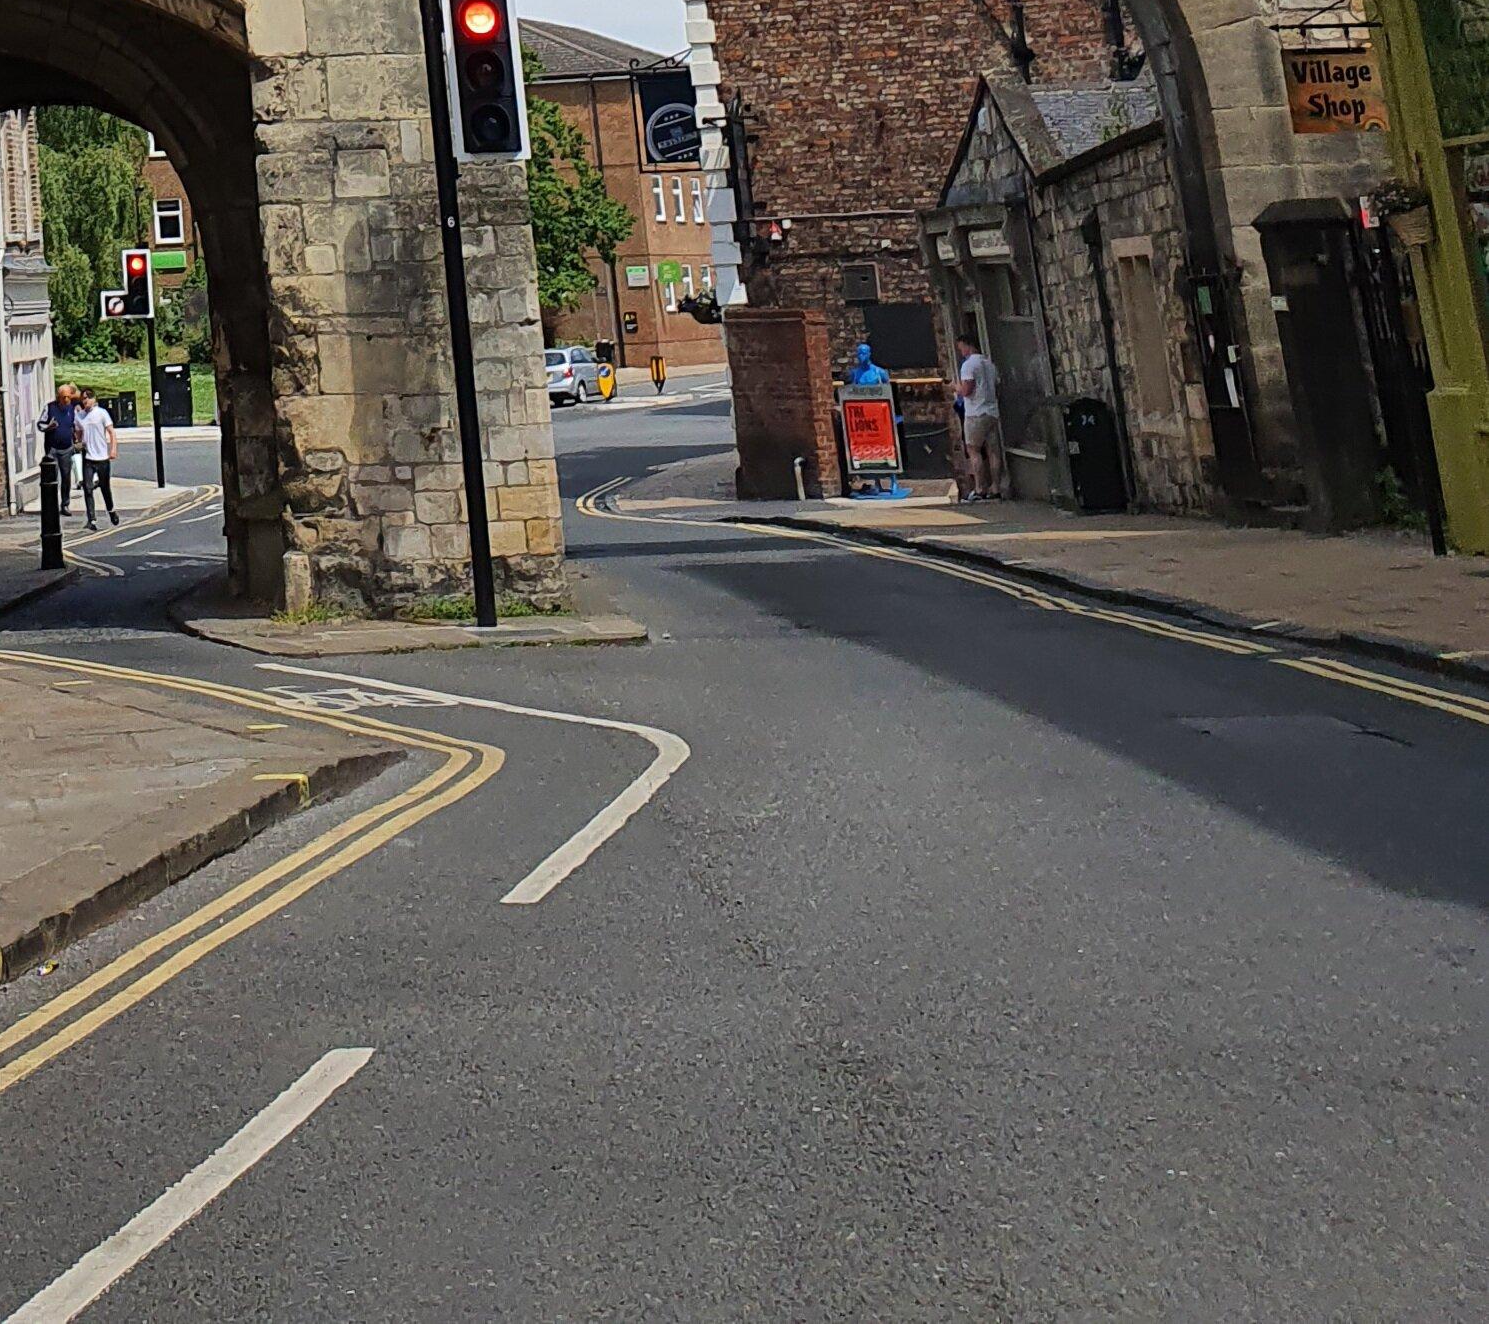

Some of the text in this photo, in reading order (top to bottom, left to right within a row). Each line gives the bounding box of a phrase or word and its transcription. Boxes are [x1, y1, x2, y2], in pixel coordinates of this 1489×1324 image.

[1291, 59, 1372, 89] Village
[1308, 93, 1366, 124] Shop
[447, 216, 455, 227] 6
